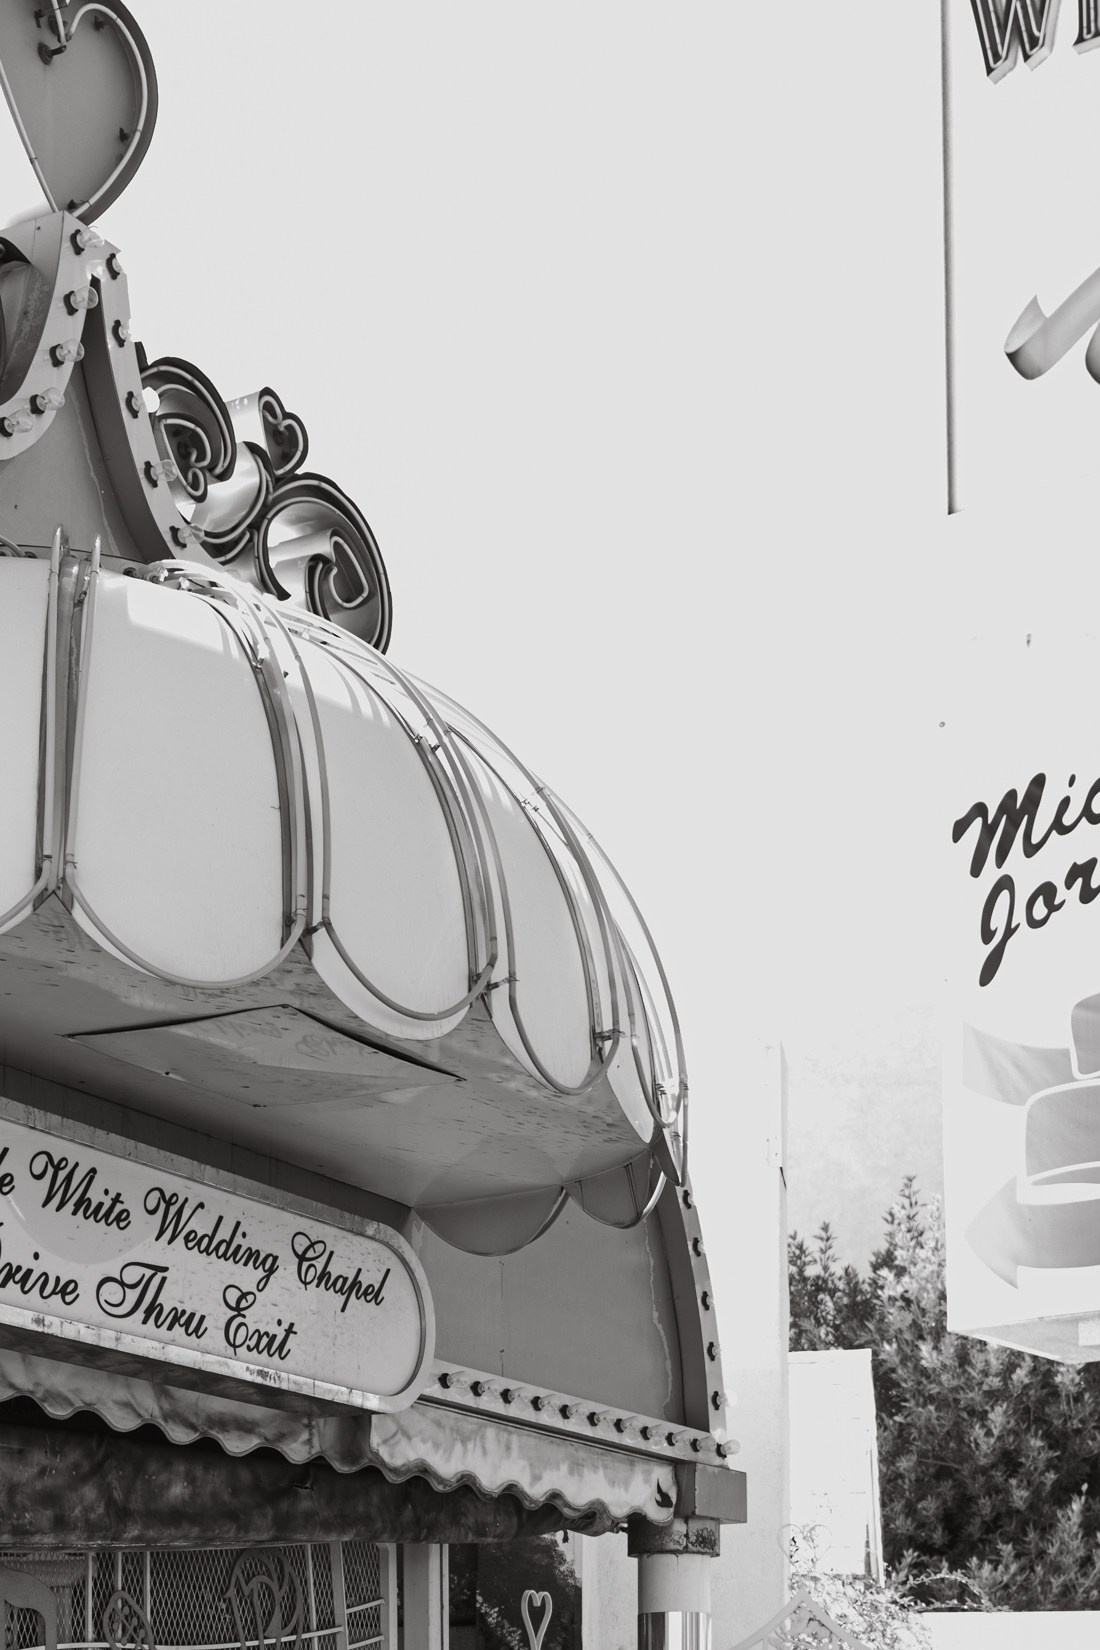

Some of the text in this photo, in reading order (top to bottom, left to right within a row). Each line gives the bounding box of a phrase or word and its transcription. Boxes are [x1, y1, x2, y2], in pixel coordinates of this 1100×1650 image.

[0, 1236, 298, 1360] rive Thru Exit
[29, 1151, 131, 1230] White
[144, 1187, 280, 1291] Wedding
[291, 1232, 391, 1312] Chapel
